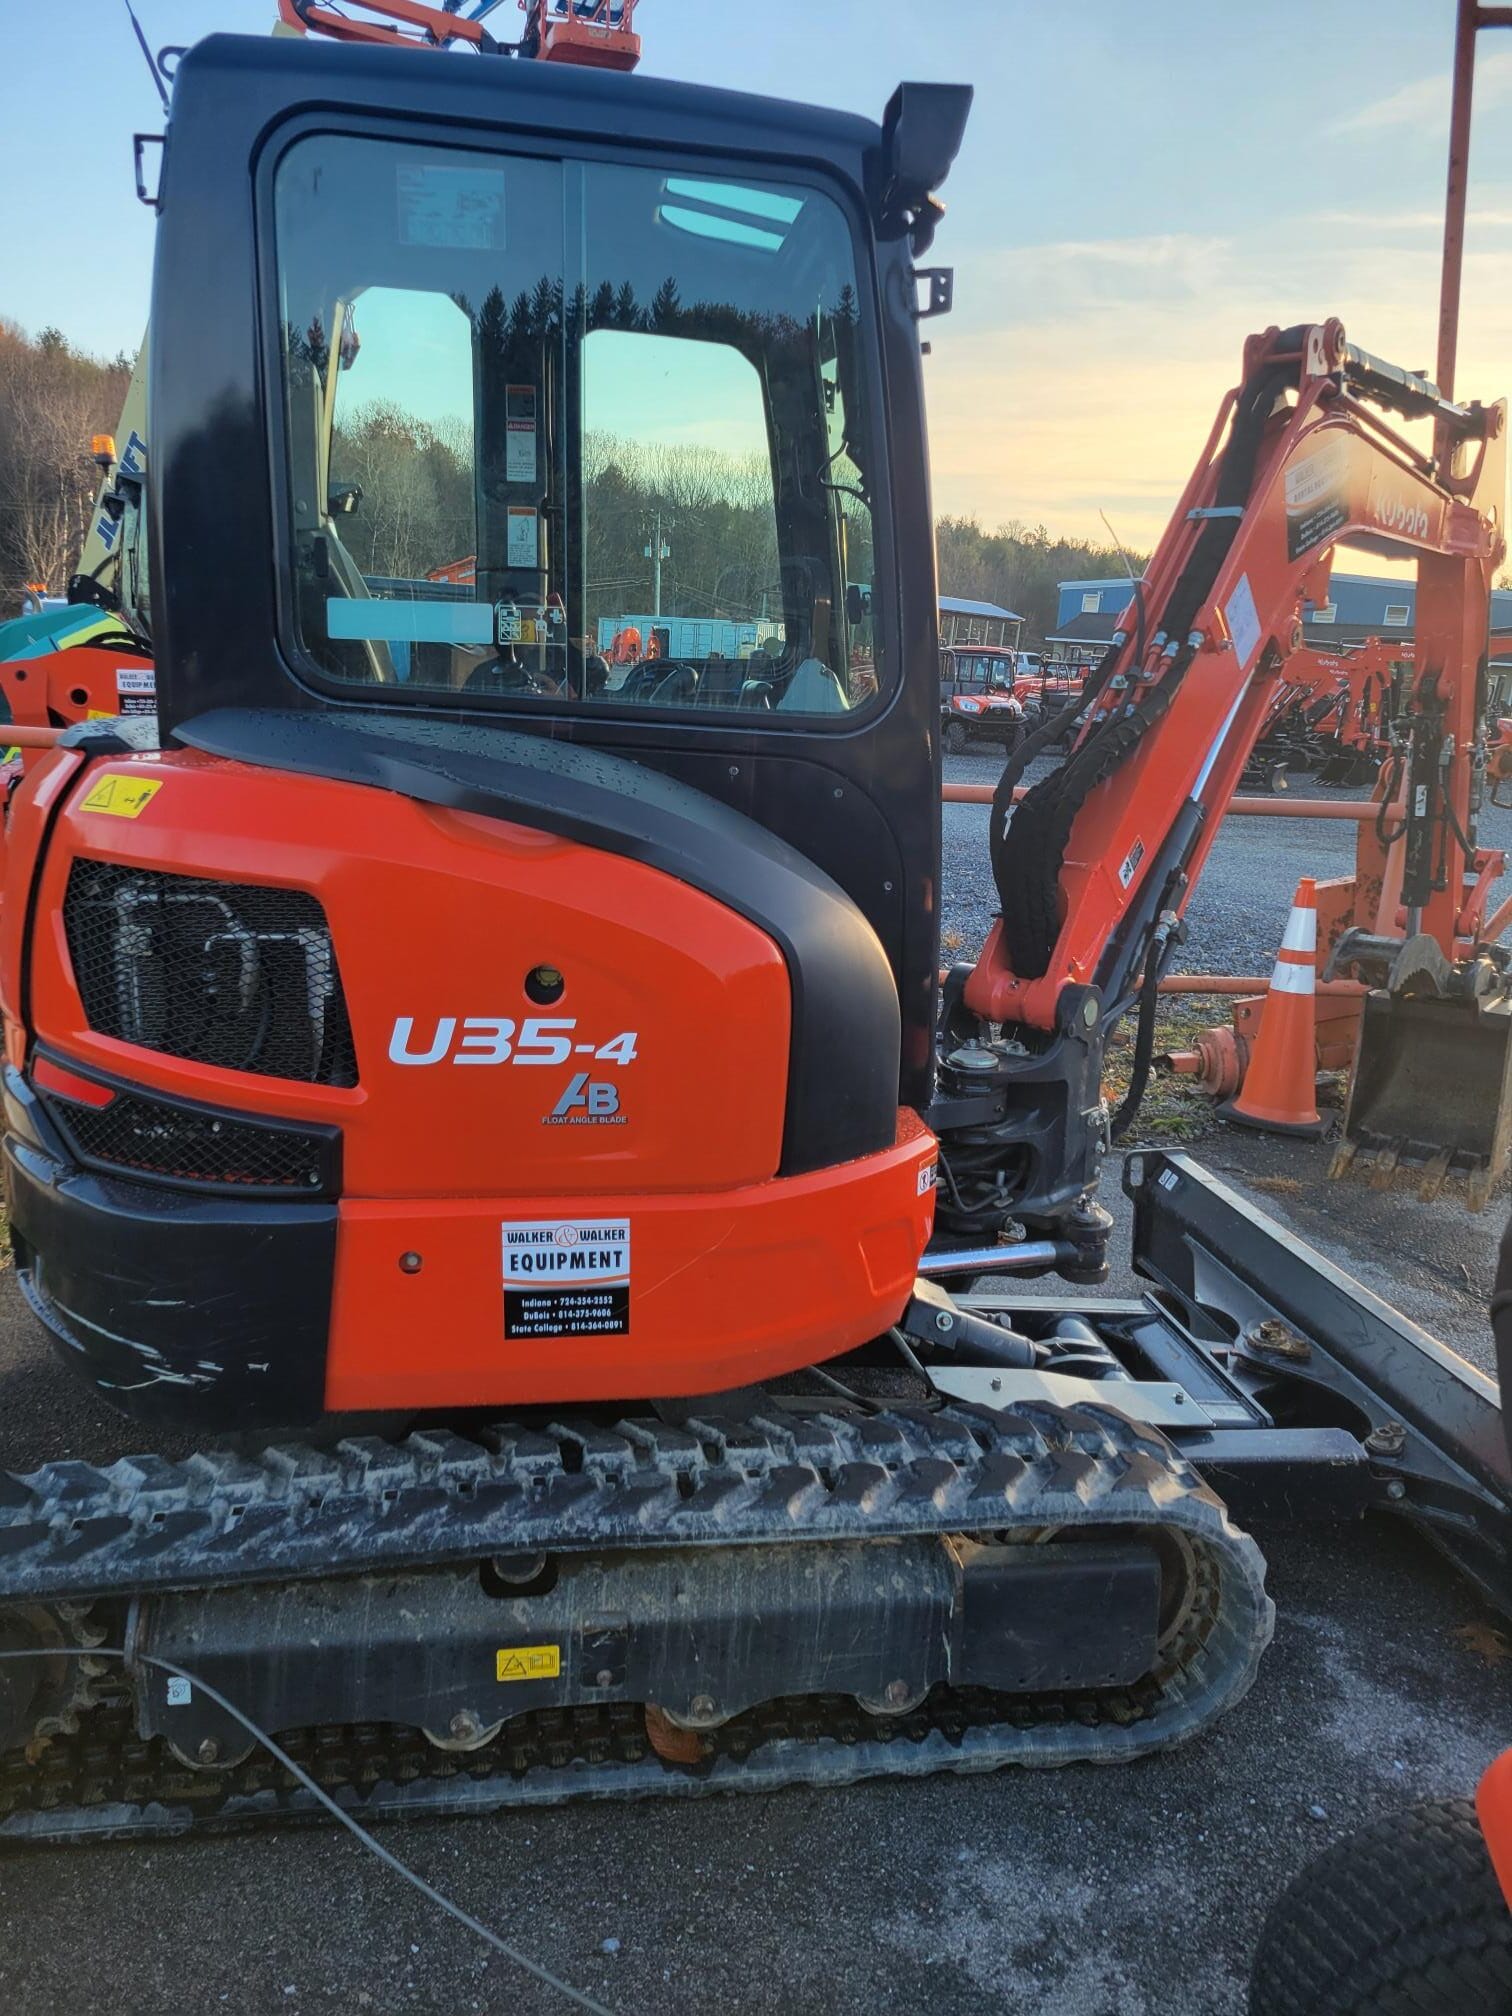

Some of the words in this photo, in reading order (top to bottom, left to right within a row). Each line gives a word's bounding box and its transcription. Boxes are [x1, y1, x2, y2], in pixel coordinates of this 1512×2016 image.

[96, 516, 119, 551] JL
[120, 430, 149, 473] IFT
[1374, 495, 1428, 538] Kubota
[388, 1017, 638, 1065] U35-4
[542, 1116, 568, 1124] FLOAT
[569, 1116, 598, 1124] ANGLE
[600, 1116, 627, 1124] BLADE
[507, 1231, 553, 1243] WALKER
[580, 1229, 625, 1241] WALKER
[510, 1251, 622, 1272] EQUIPMENT
[522, 1299, 551, 1308] Indiana
[560, 1296, 613, 1306] 724-354-2552
[523, 1311, 550, 1320] DuBois
[558, 1309, 611, 1319] 814-375-9606
[511, 1325, 532, 1334] State
[534, 1323, 563, 1334] College
[571, 1321, 623, 1331] 814-364-0891
